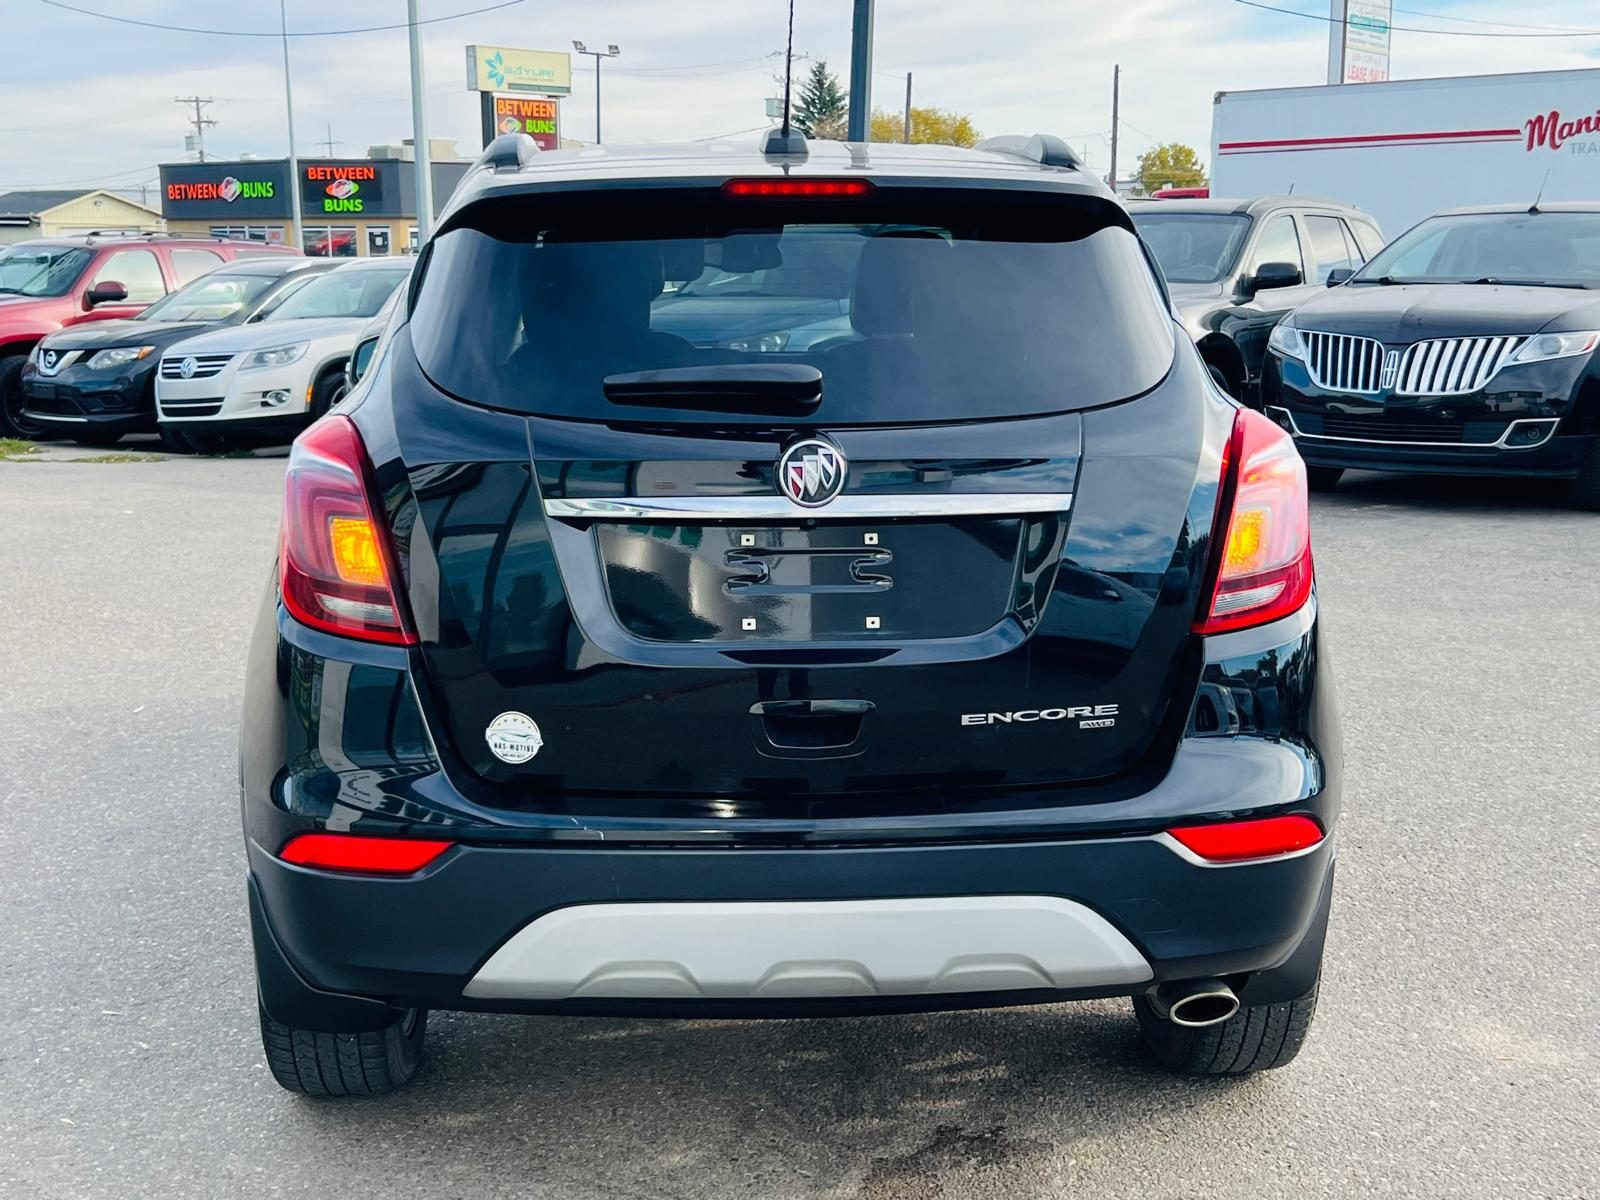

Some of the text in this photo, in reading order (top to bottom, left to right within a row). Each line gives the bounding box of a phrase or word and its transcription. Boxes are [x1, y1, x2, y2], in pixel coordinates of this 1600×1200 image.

[497, 99, 556, 118] BETWEEN
[526, 118, 556, 134] BUNS
[1524, 109, 1600, 152] Mani
[307, 166, 375, 180] BETWEEN
[167, 181, 274, 200] BETWEEN BUNS
[324, 198, 364, 213] BUNS
[960, 703, 1119, 726] ENCORE
[1080, 719, 1114, 728] AWD
